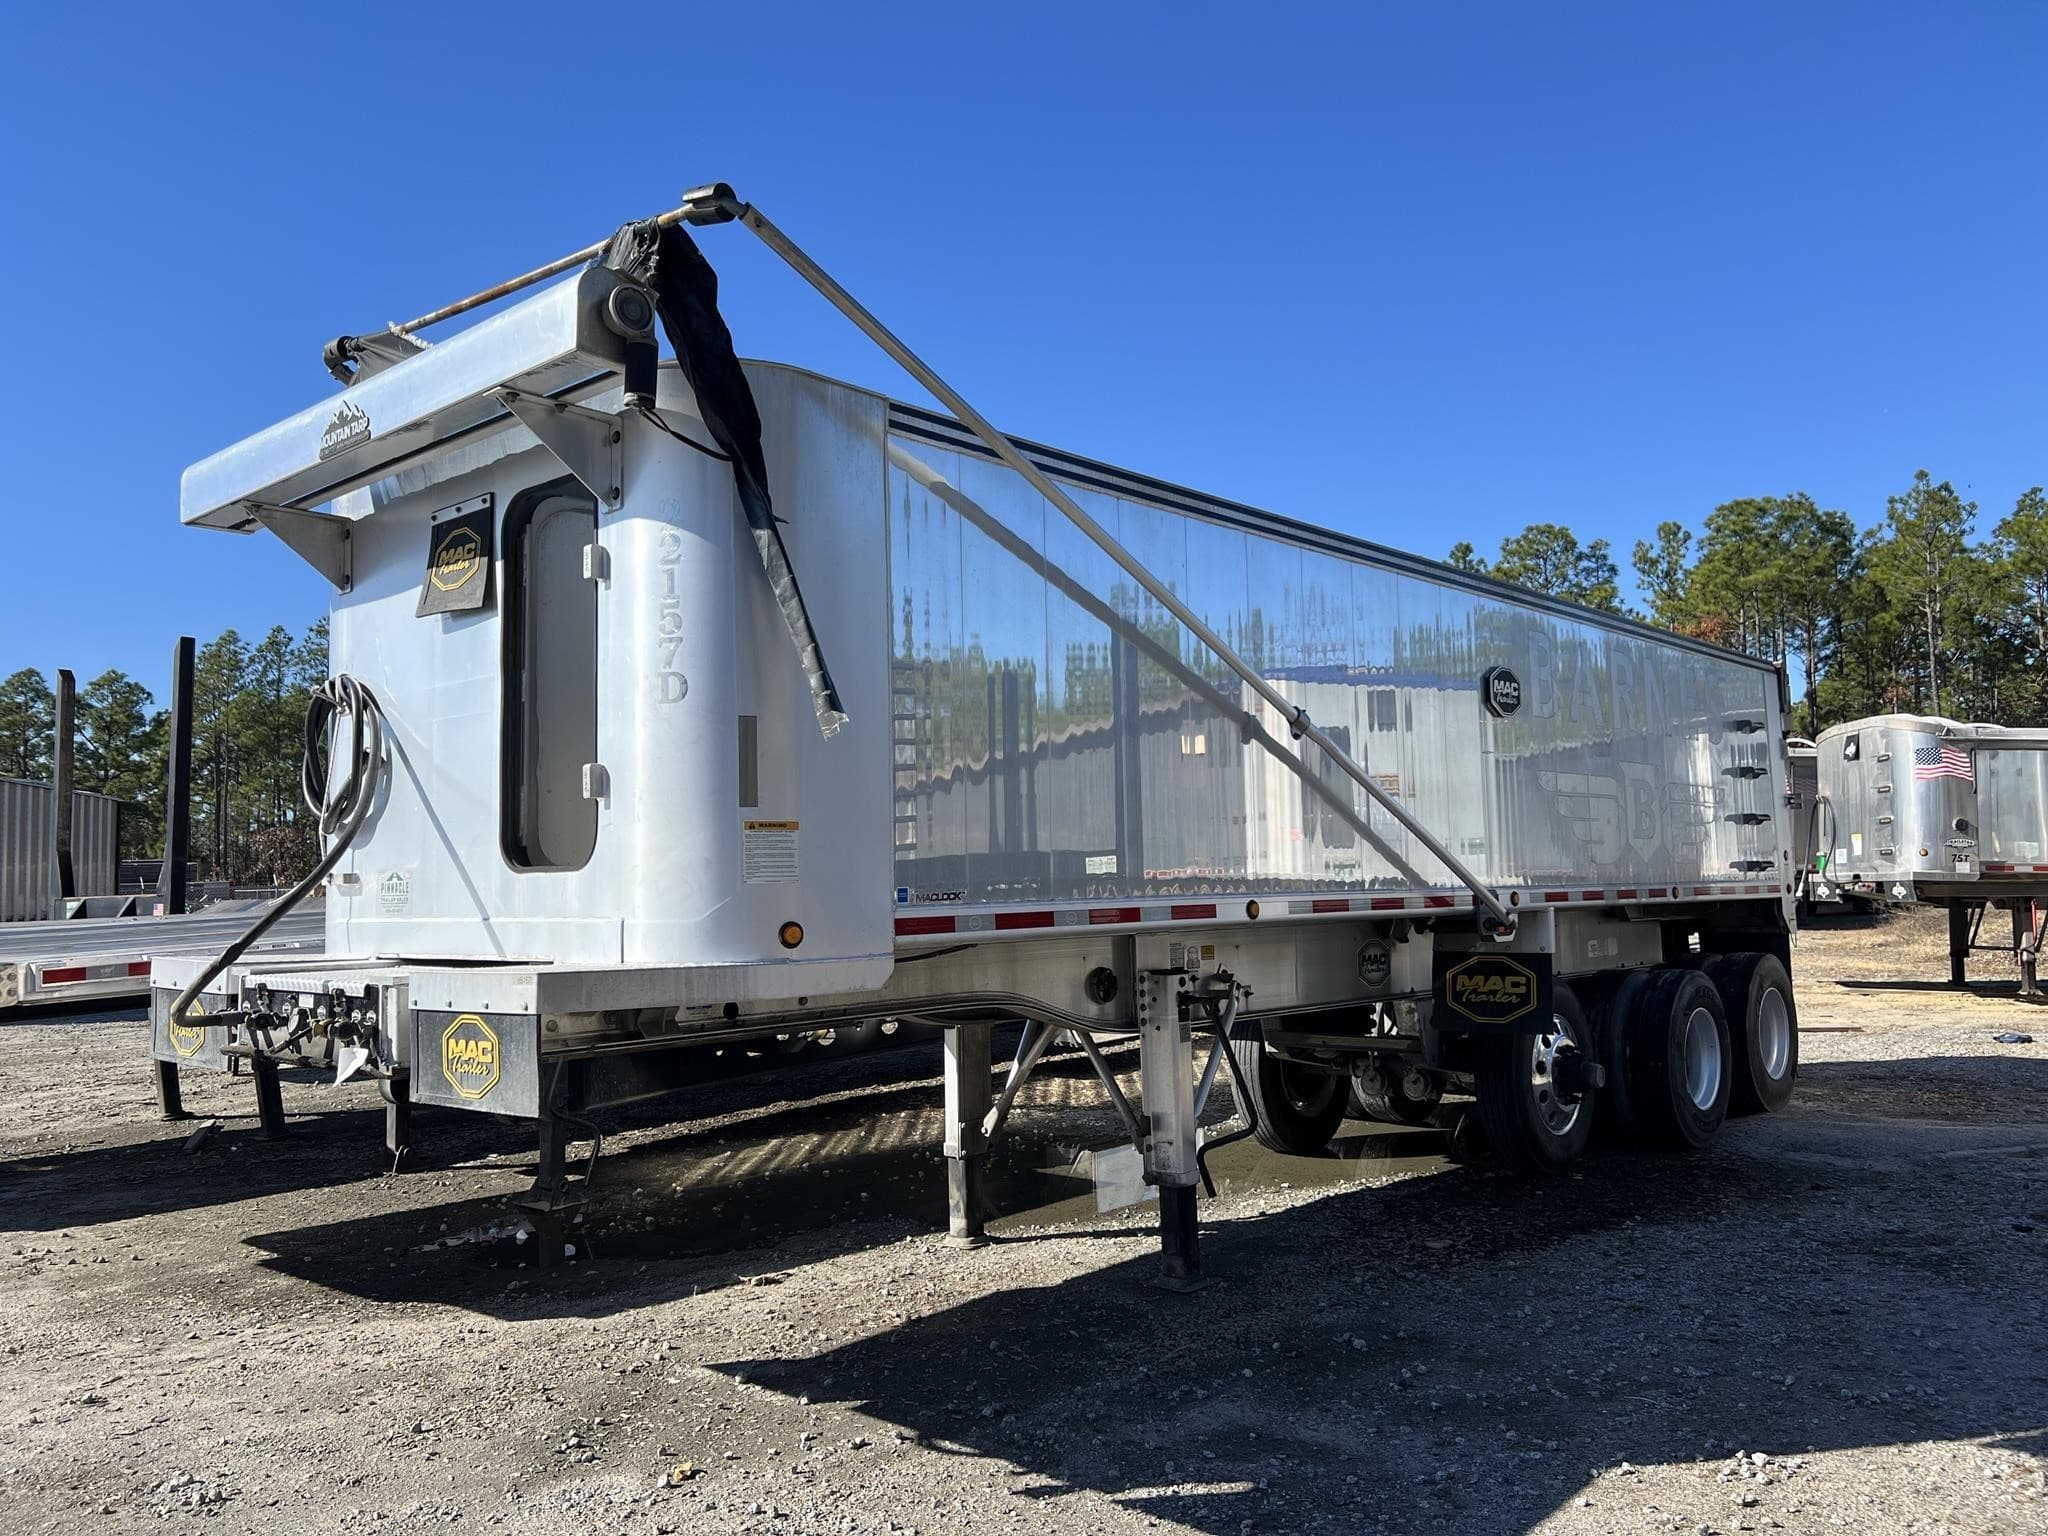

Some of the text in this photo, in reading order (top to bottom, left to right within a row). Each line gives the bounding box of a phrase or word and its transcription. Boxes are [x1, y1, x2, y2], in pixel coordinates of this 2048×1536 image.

[320, 425, 351, 449] MOUNTAIN
[350, 417, 368, 436] TARP
[438, 542, 477, 567] MAC
[1493, 679, 1519, 697] MAC
[1951, 853, 1970, 863] 75T
[381, 881, 409, 894] PINNACLE
[916, 891, 962, 903] MACLOCK
[1361, 952, 1387, 967] MAC
[1456, 975, 1527, 994] MAC
[1461, 986, 1521, 1003] Trailer
[447, 1039, 493, 1063] MAC
[450, 1053, 489, 1076] Trailer
